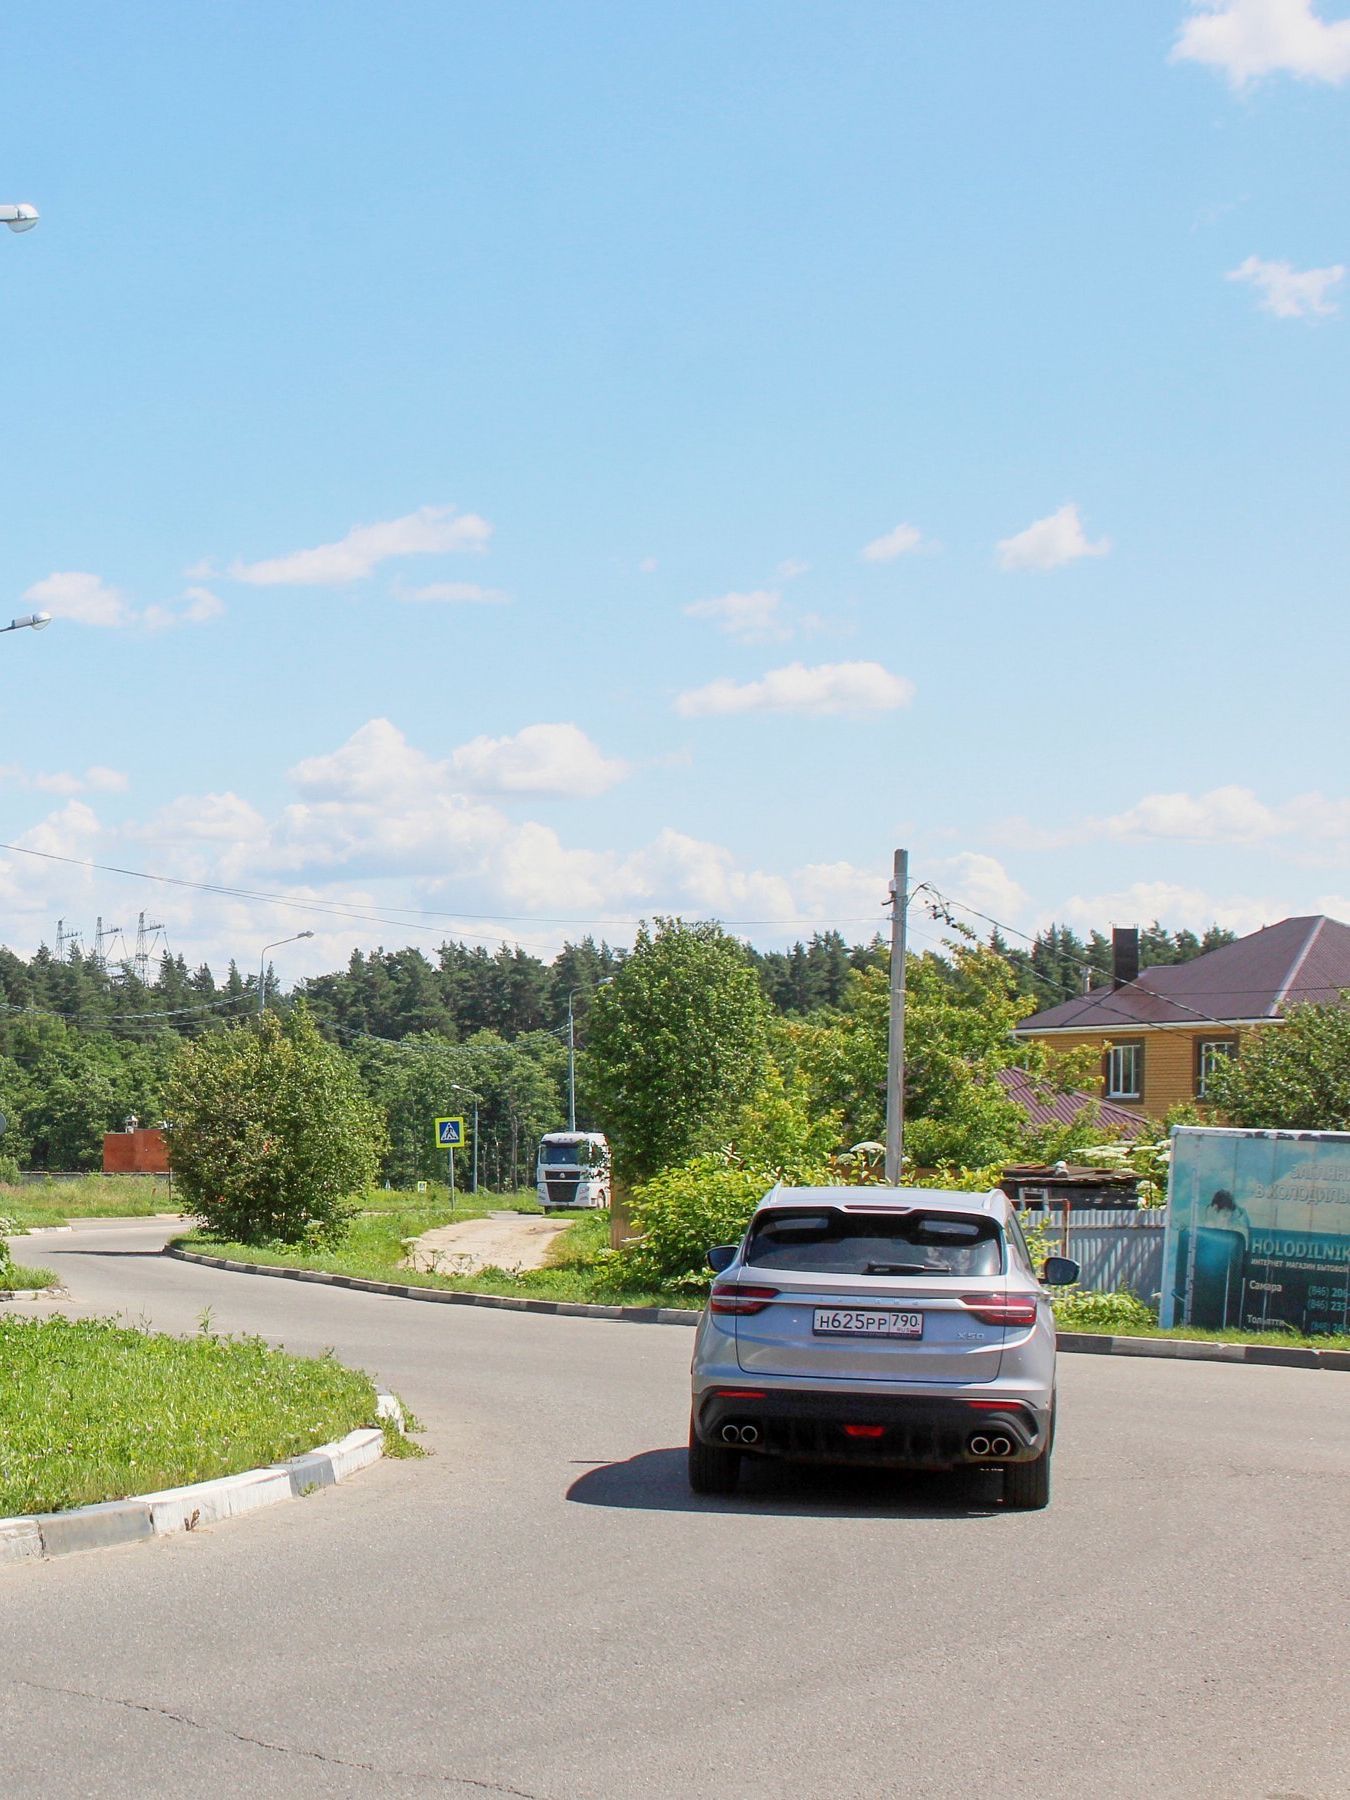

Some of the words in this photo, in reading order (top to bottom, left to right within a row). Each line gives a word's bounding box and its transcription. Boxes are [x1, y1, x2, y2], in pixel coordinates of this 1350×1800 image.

[1291, 1164, 1350, 1181] ЗАГЛЯН
[1267, 1185, 1350, 1205] ХОЛОДИЛЬ
[1249, 1280, 1282, 1293] Самара
[891, 1313, 918, 1328] 790
[957, 1331, 985, 1340] X50
